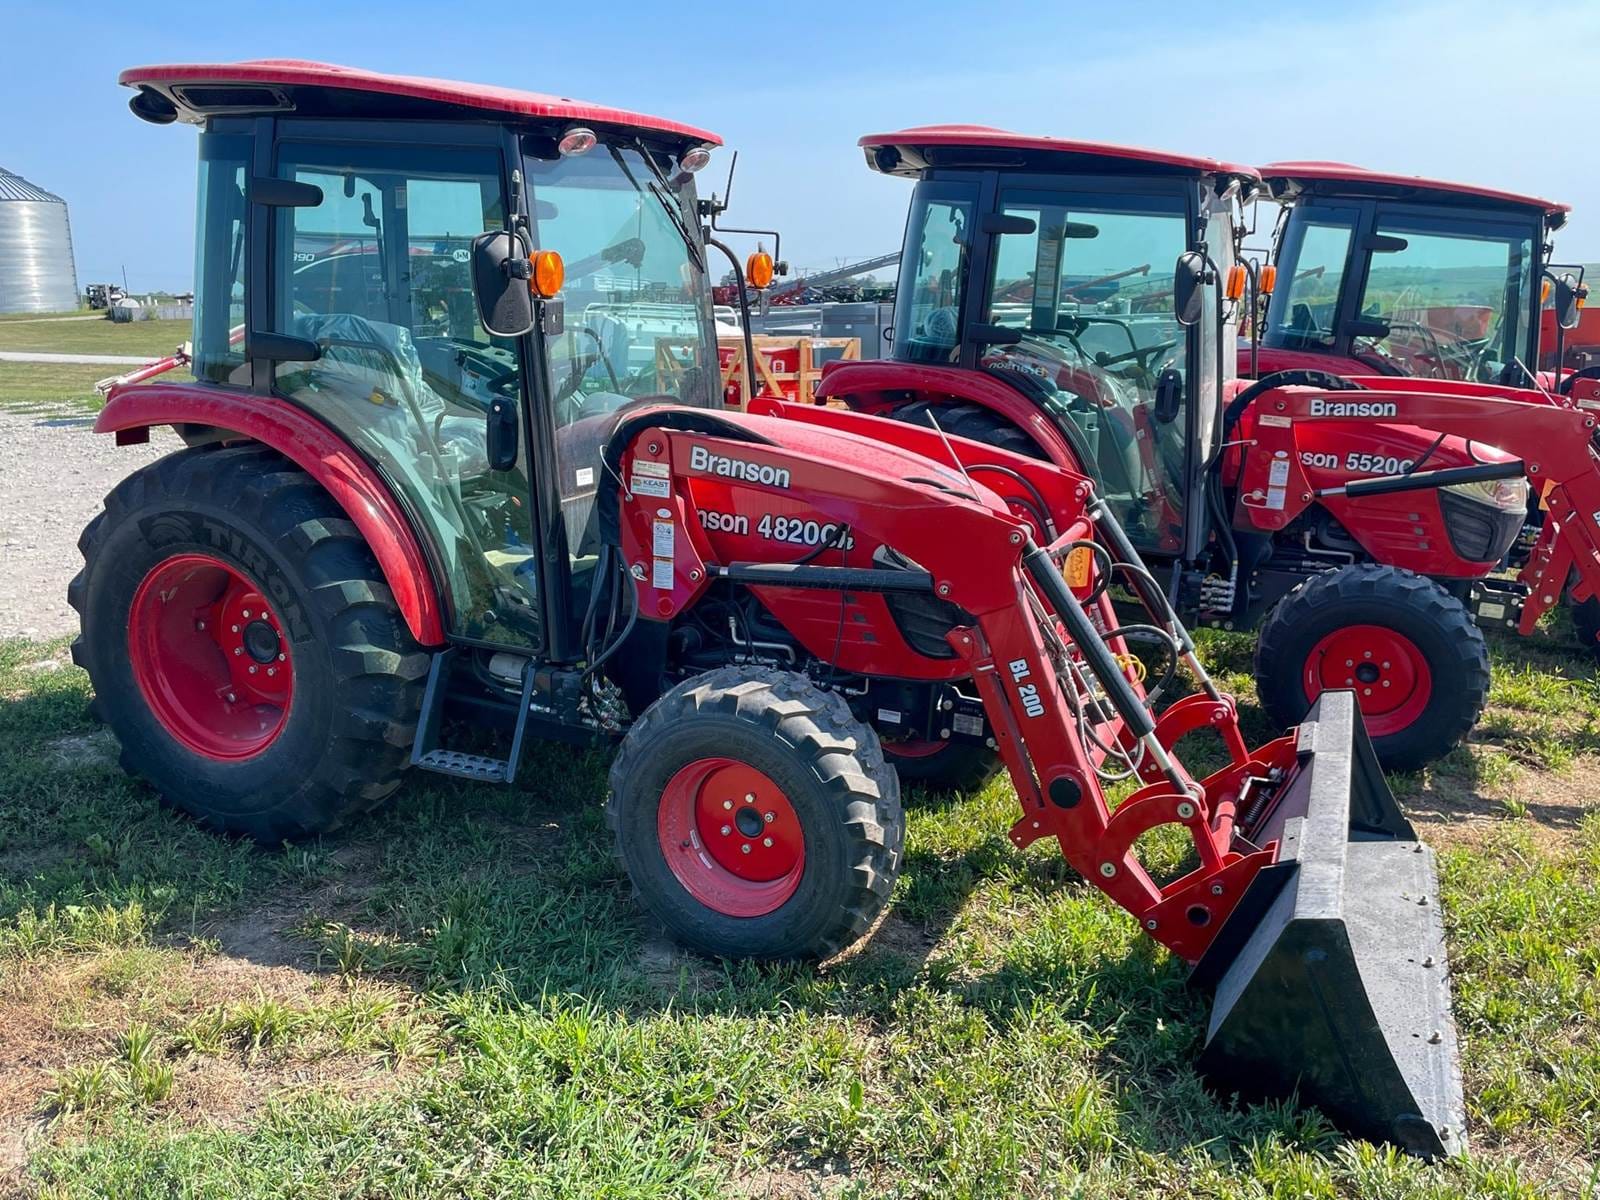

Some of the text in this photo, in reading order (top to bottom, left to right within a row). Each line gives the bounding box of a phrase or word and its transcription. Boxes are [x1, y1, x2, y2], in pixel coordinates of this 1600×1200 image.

[1311, 399, 1397, 417] Branson
[690, 446, 790, 488] Branson
[1009, 658, 1045, 717] BL 200
